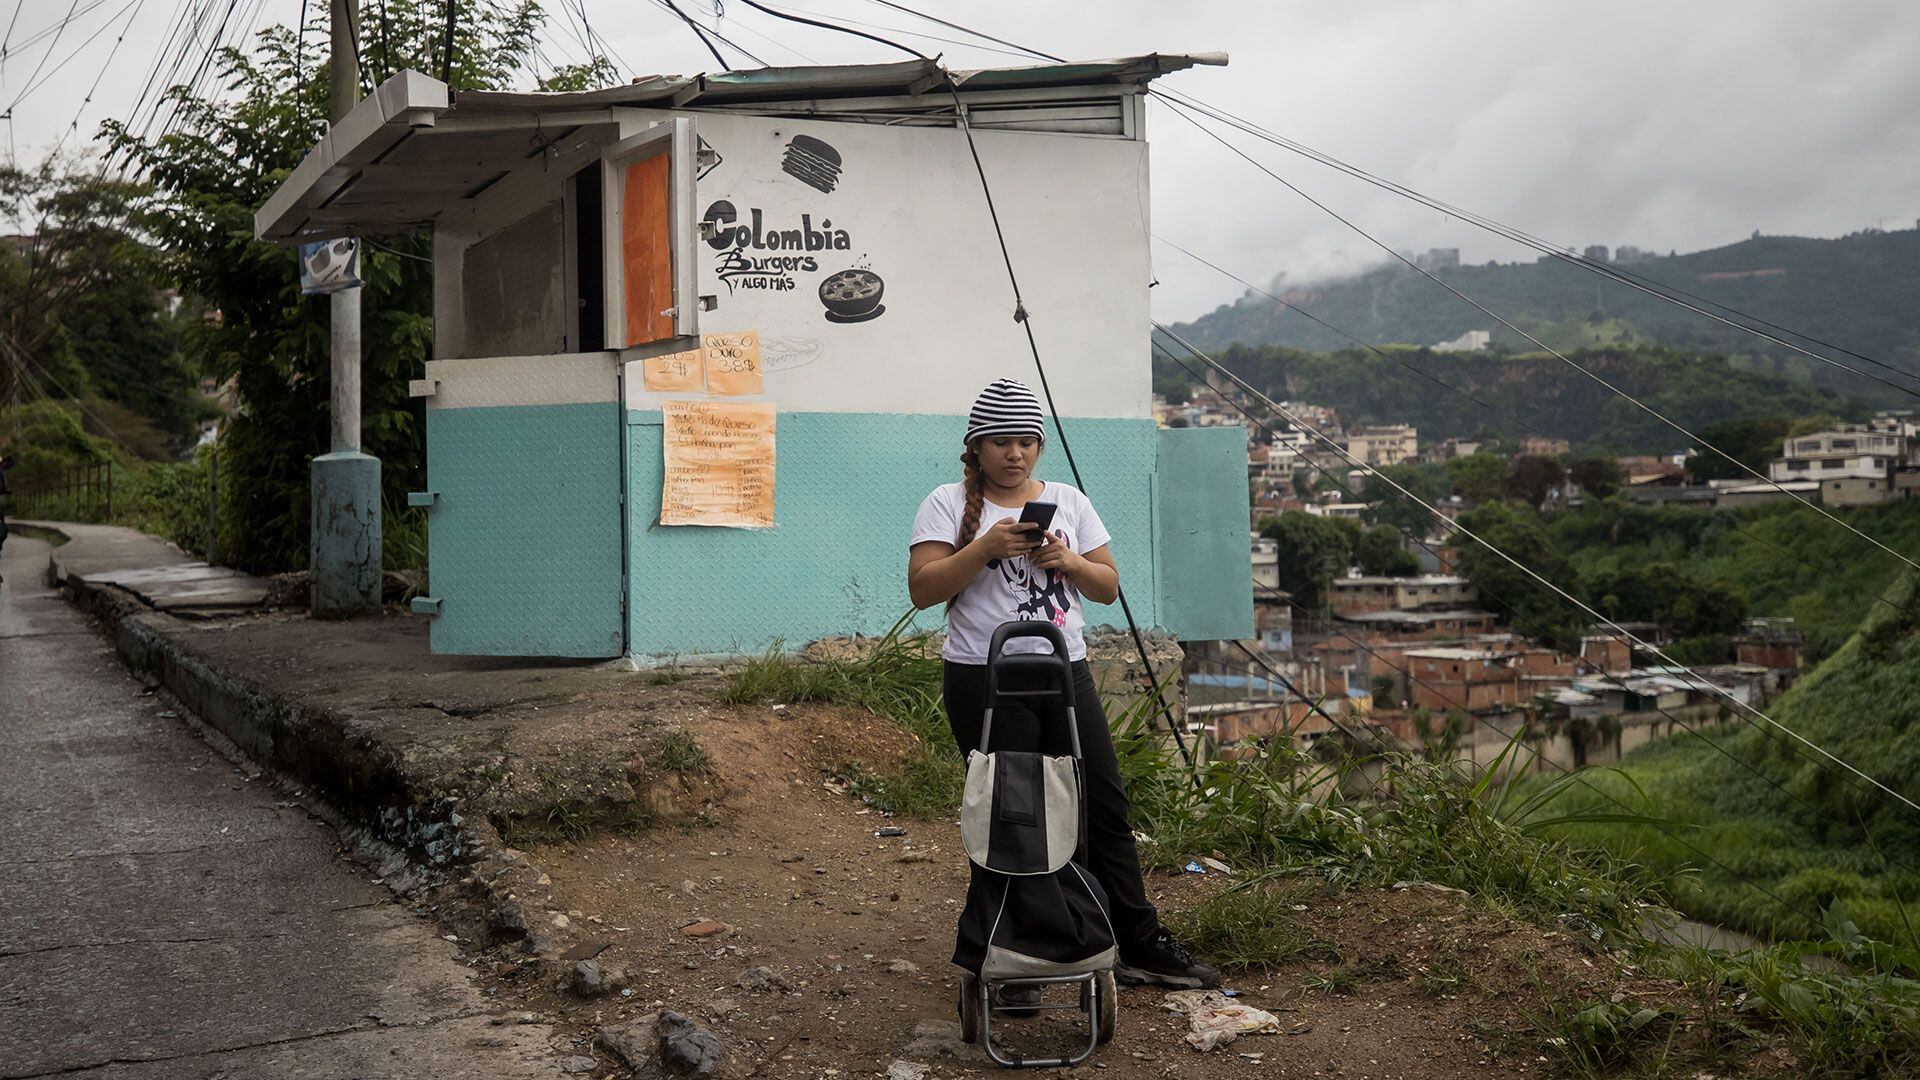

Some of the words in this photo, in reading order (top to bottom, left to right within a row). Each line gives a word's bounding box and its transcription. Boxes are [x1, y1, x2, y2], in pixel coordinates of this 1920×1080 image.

[702, 200, 851, 251] Colombia
[715, 248, 819, 276] Burgers
[742, 277, 767, 290] ALGO
